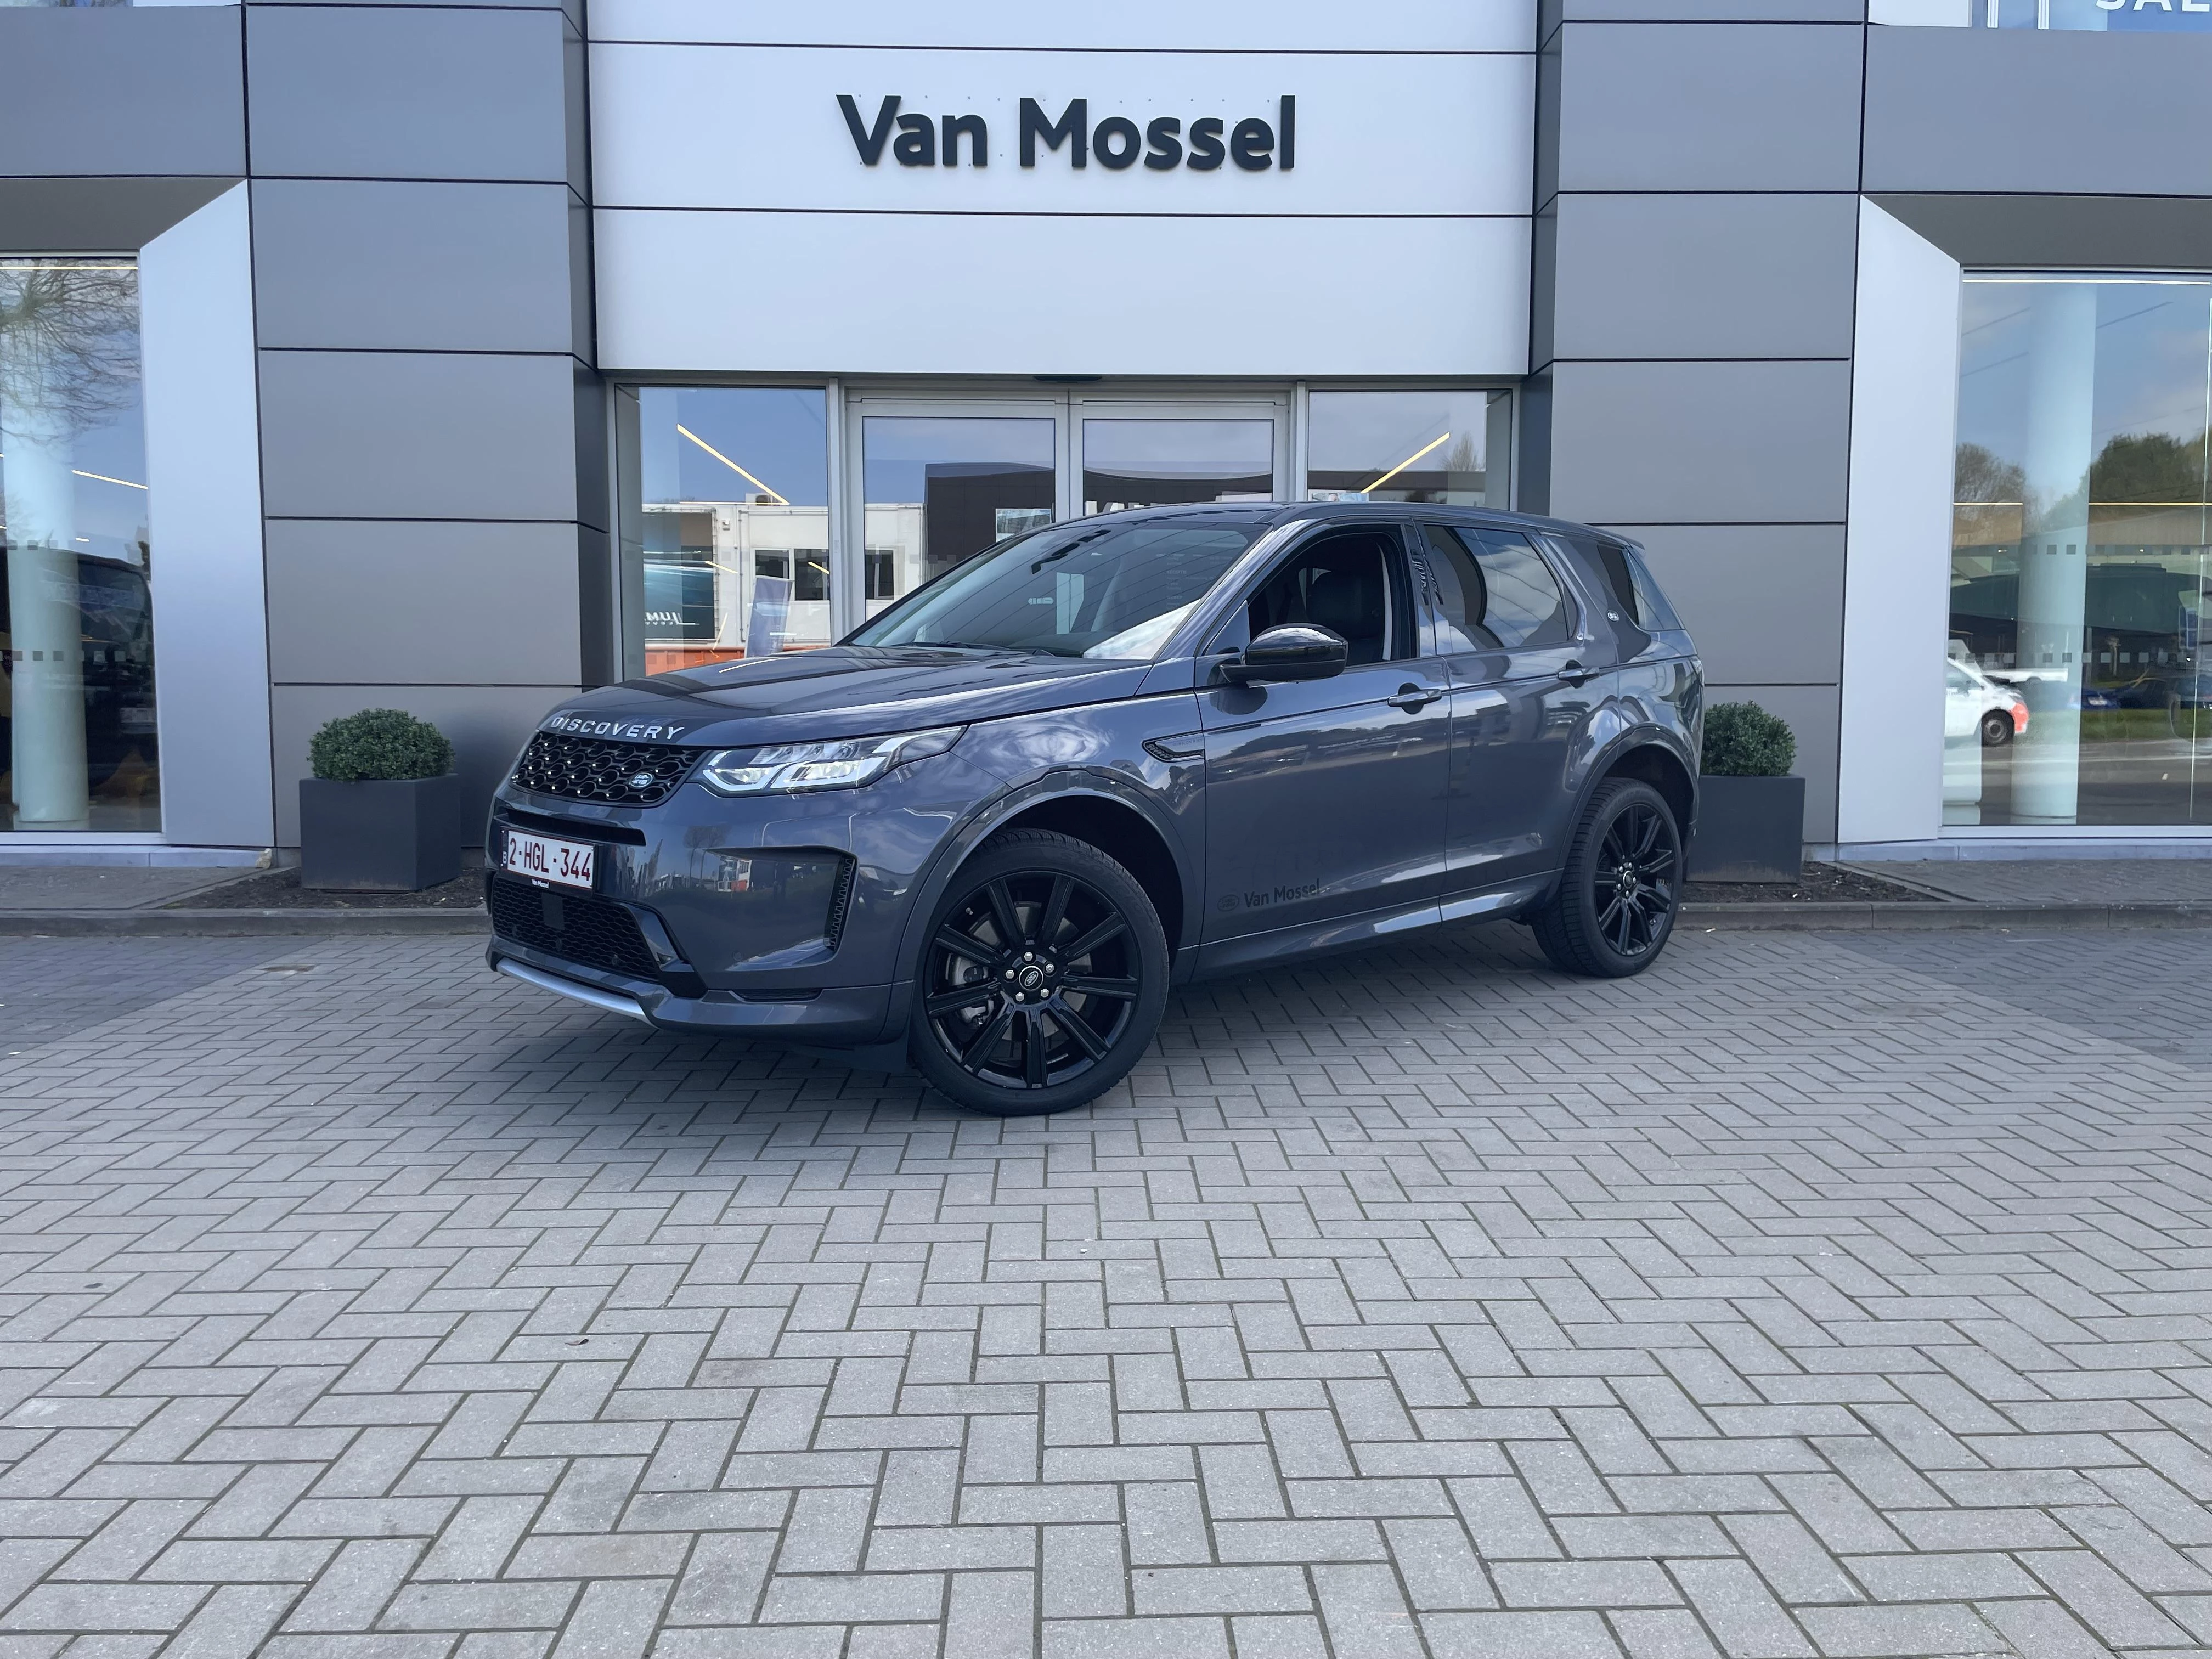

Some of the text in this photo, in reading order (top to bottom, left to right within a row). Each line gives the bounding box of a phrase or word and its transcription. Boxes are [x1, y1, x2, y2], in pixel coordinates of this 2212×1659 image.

[836, 94, 1296, 170] Van Mossel
[551, 717, 685, 739] DISCOVERY
[503, 851, 507, 864] B
[1244, 891, 1269, 908] Van
[1273, 878, 1320, 903] Mossel
